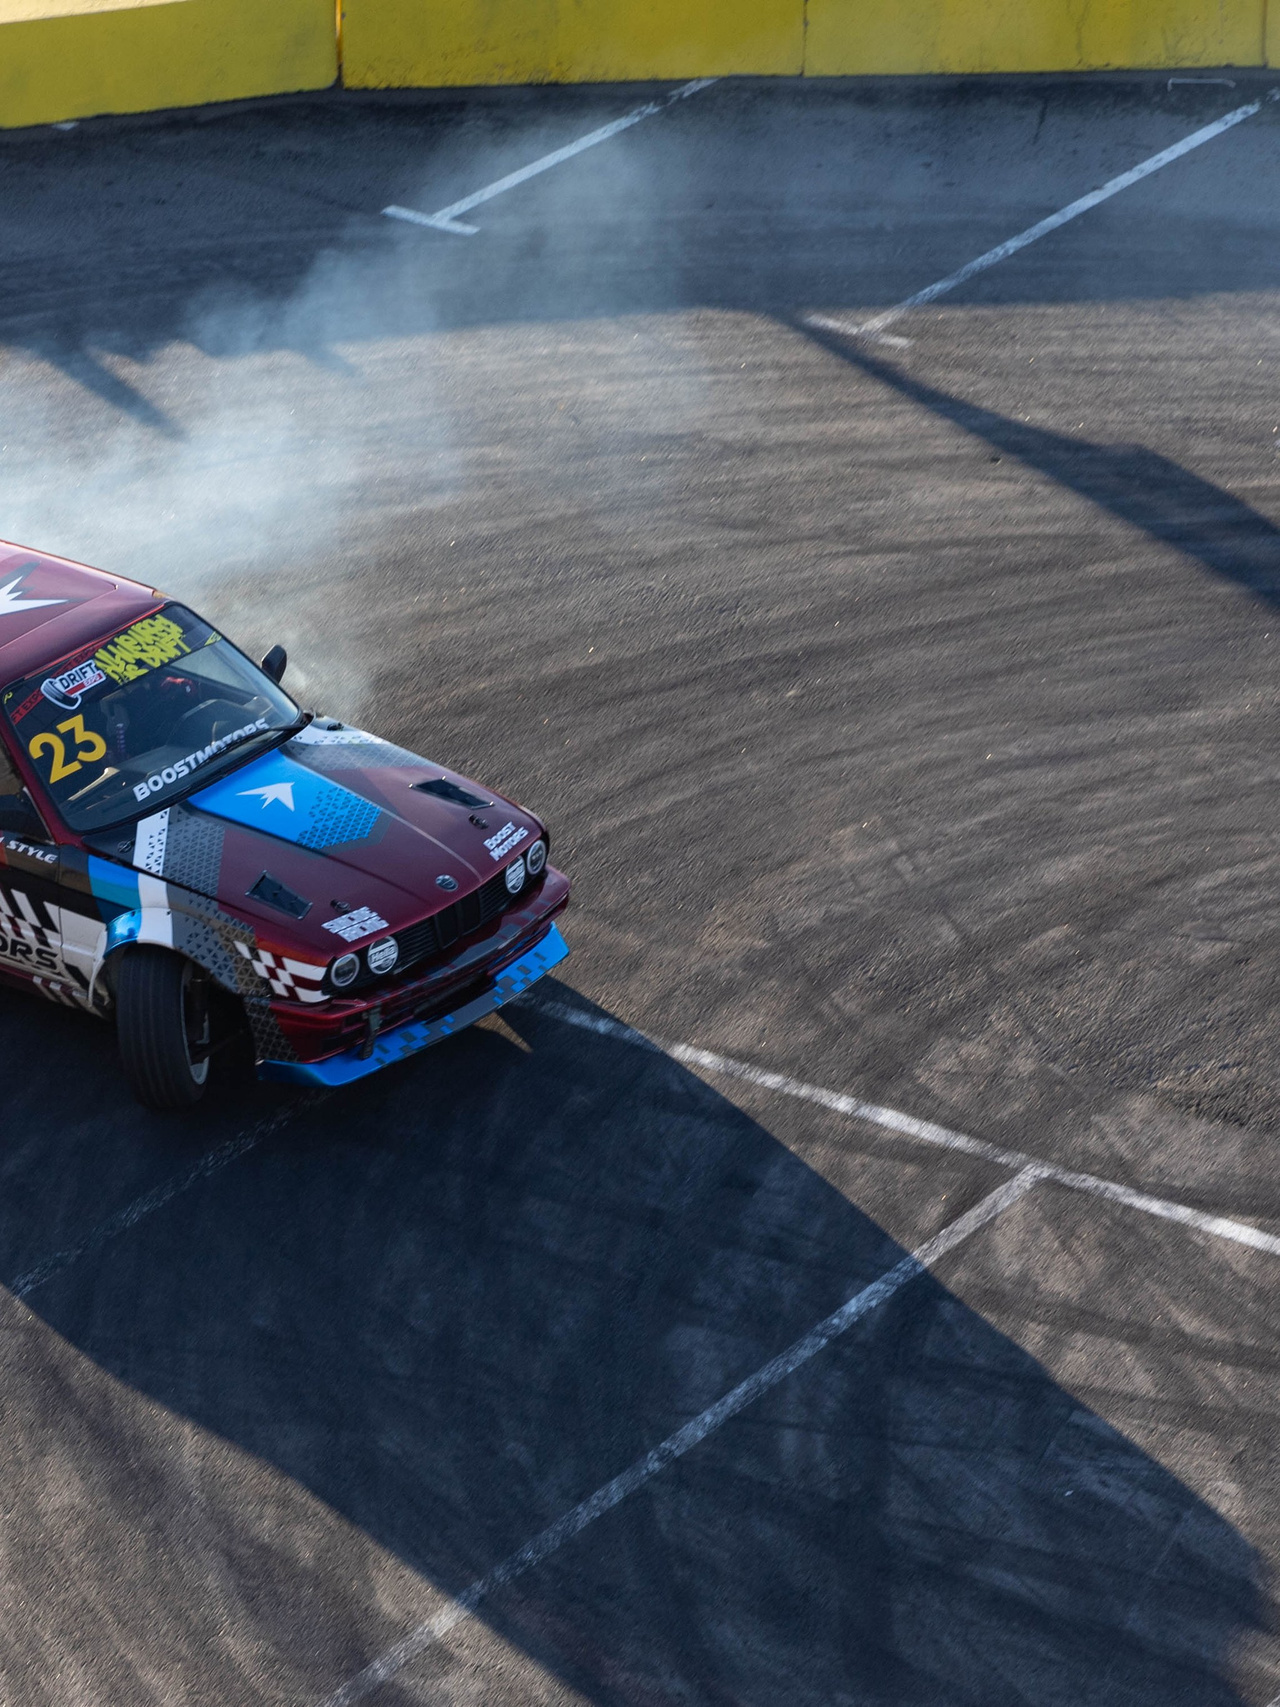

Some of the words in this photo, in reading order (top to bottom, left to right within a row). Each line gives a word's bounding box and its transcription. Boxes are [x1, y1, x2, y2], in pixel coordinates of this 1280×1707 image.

[60, 662, 96, 690] DRIFT
[29, 714, 107, 784] 23
[483, 821, 516, 850] BOOST
[489, 826, 529, 861] MOTORS
[6, 840, 58, 864] STYLE
